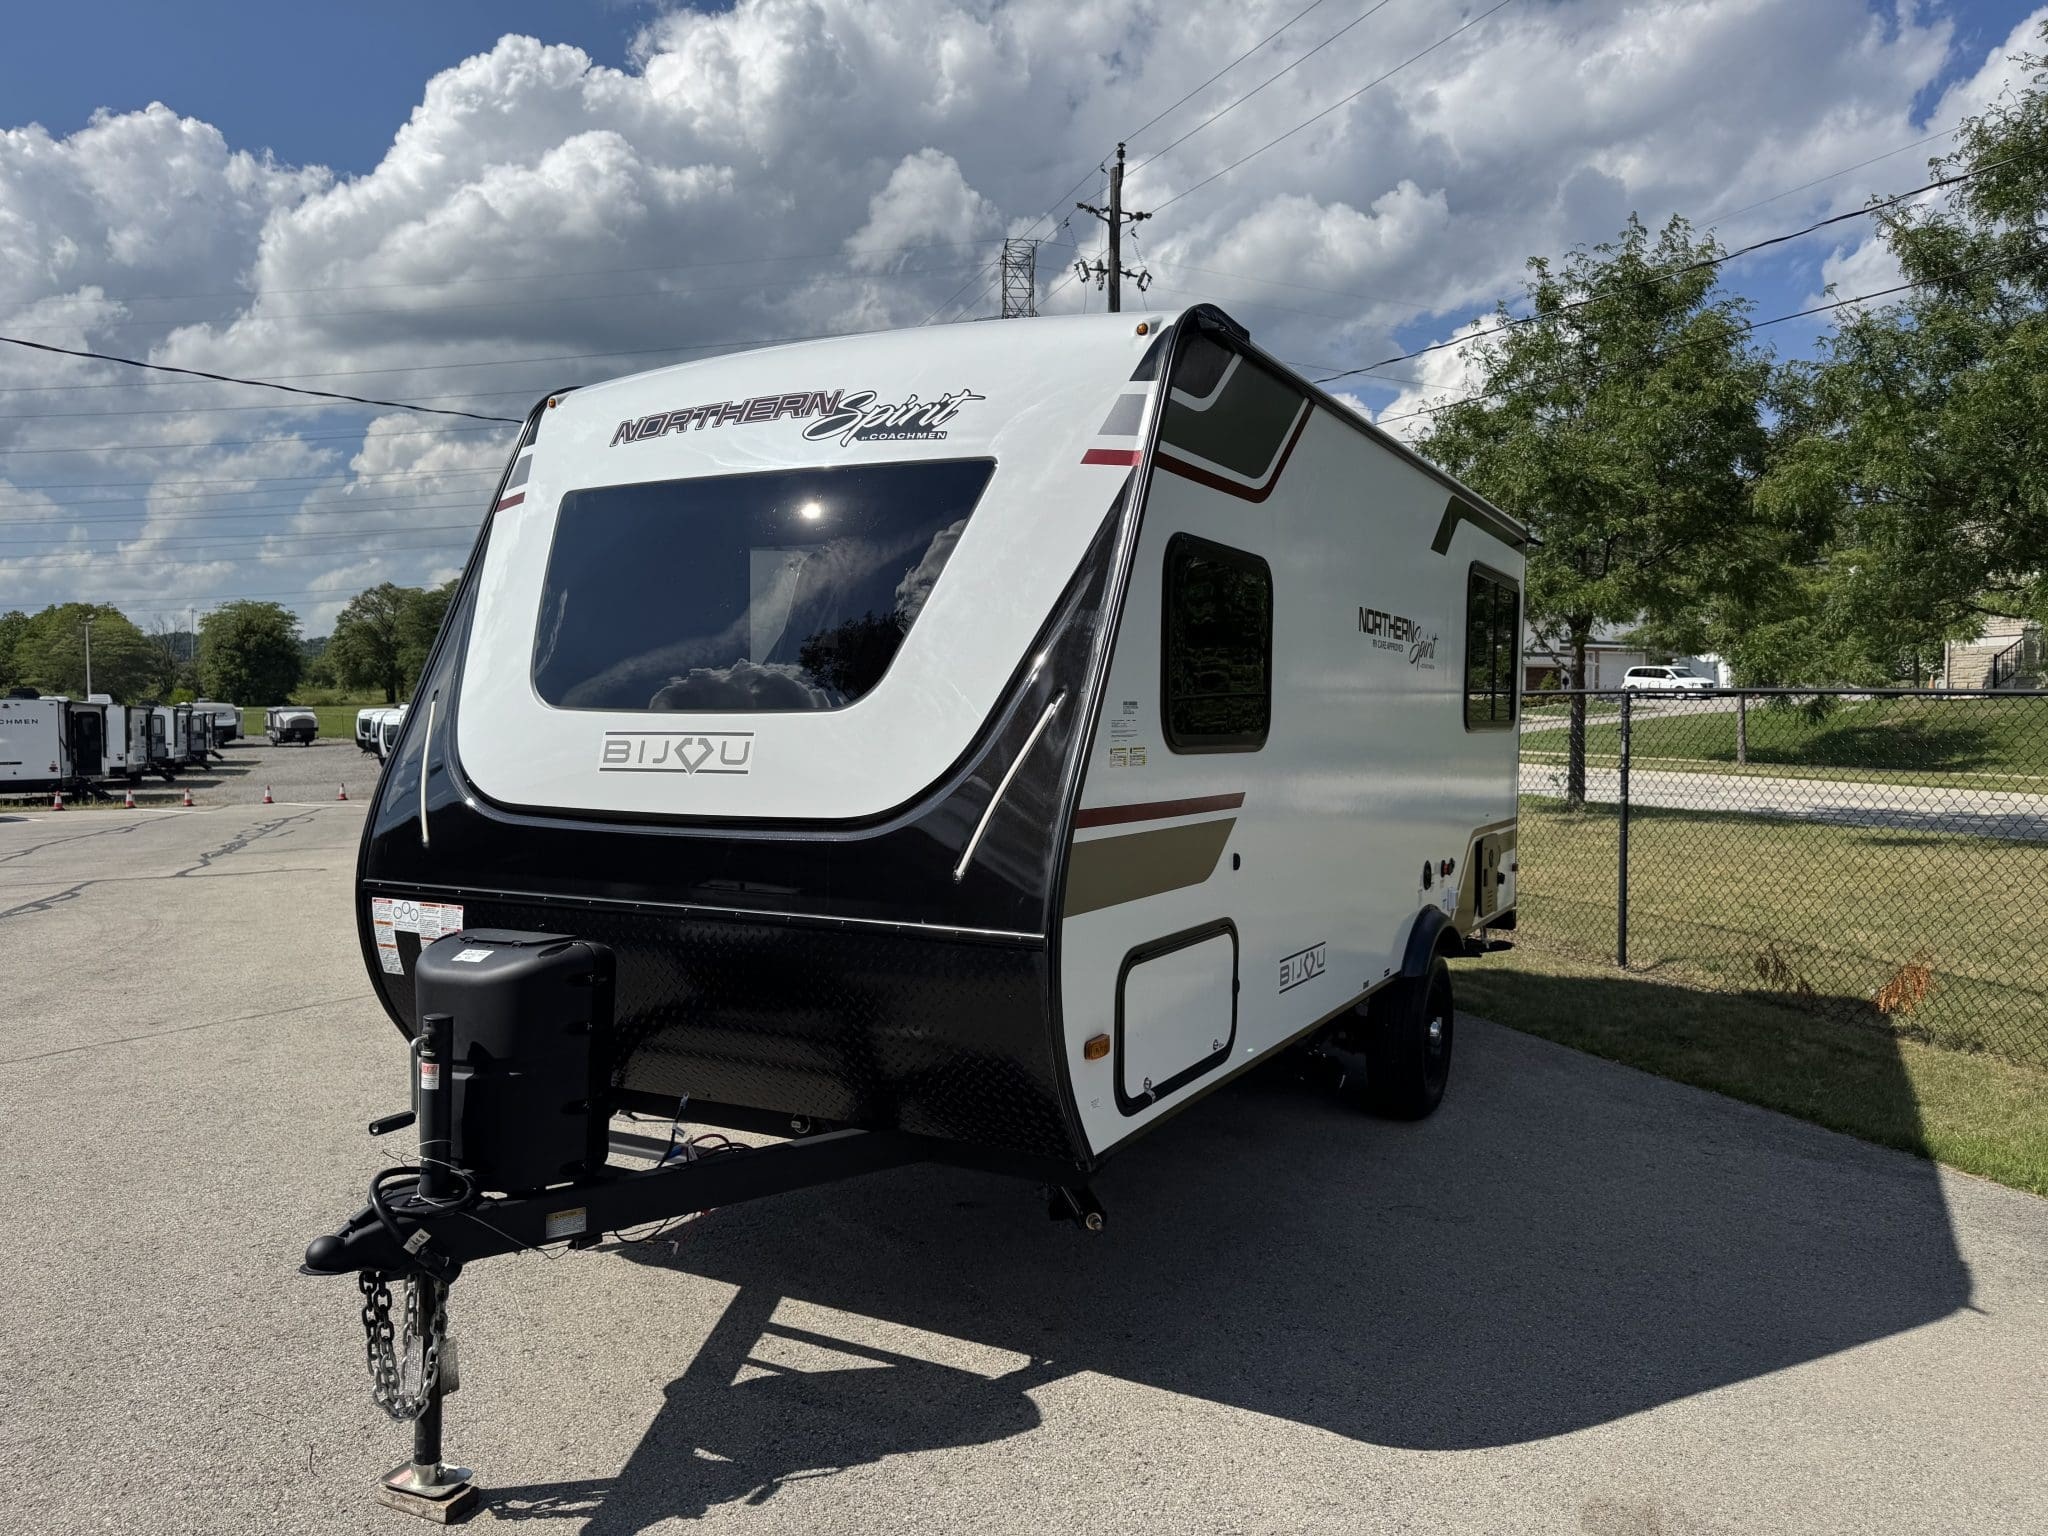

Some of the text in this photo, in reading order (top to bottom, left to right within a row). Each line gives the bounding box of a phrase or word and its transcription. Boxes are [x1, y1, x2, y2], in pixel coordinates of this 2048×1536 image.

[609, 388, 986, 448] NORTHERN Spirit
[869, 431, 947, 440] COACHMEN
[1359, 606, 1415, 643] NORTHERN
[602, 737, 751, 775] BIJOU
[1280, 947, 1326, 987] BIJOU
